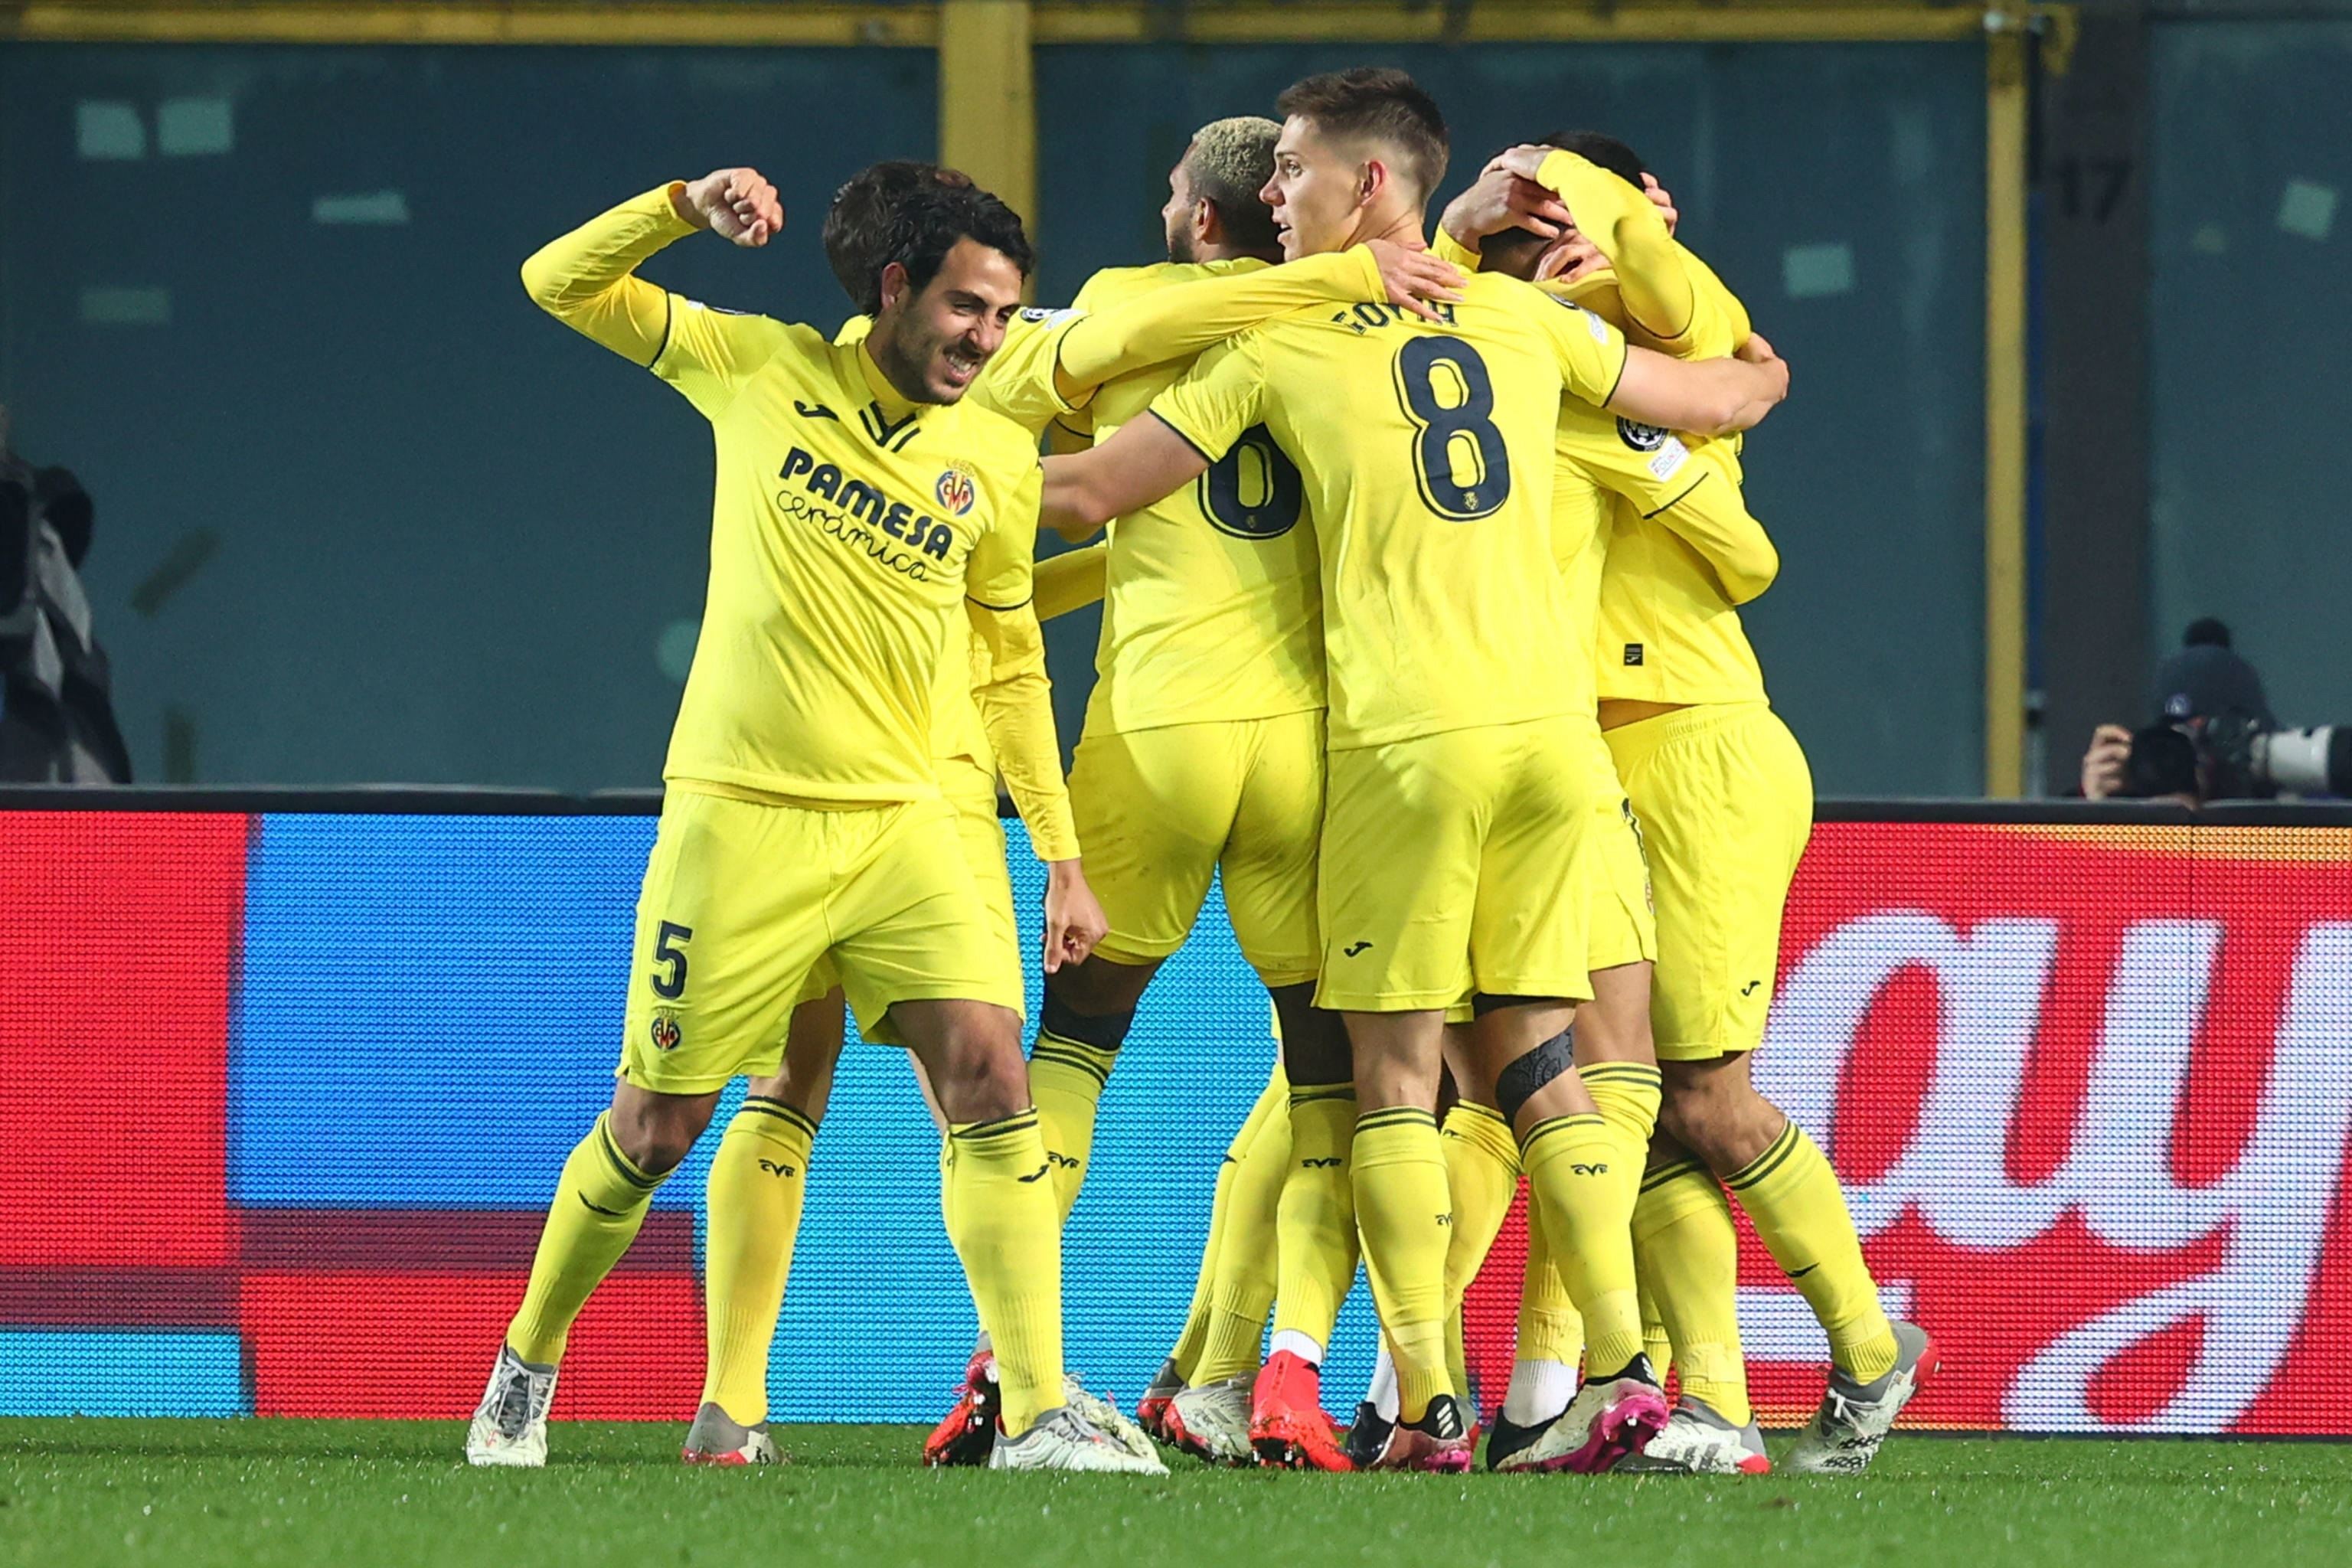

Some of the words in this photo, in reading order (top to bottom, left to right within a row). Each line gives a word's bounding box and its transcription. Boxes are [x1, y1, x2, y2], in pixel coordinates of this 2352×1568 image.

[2058, 157, 2133, 222] 17
[1391, 335, 1511, 522] 8
[779, 446, 953, 561] PAMESA
[650, 920, 693, 1001] 5
[1738, 906, 2352, 1434] ay
